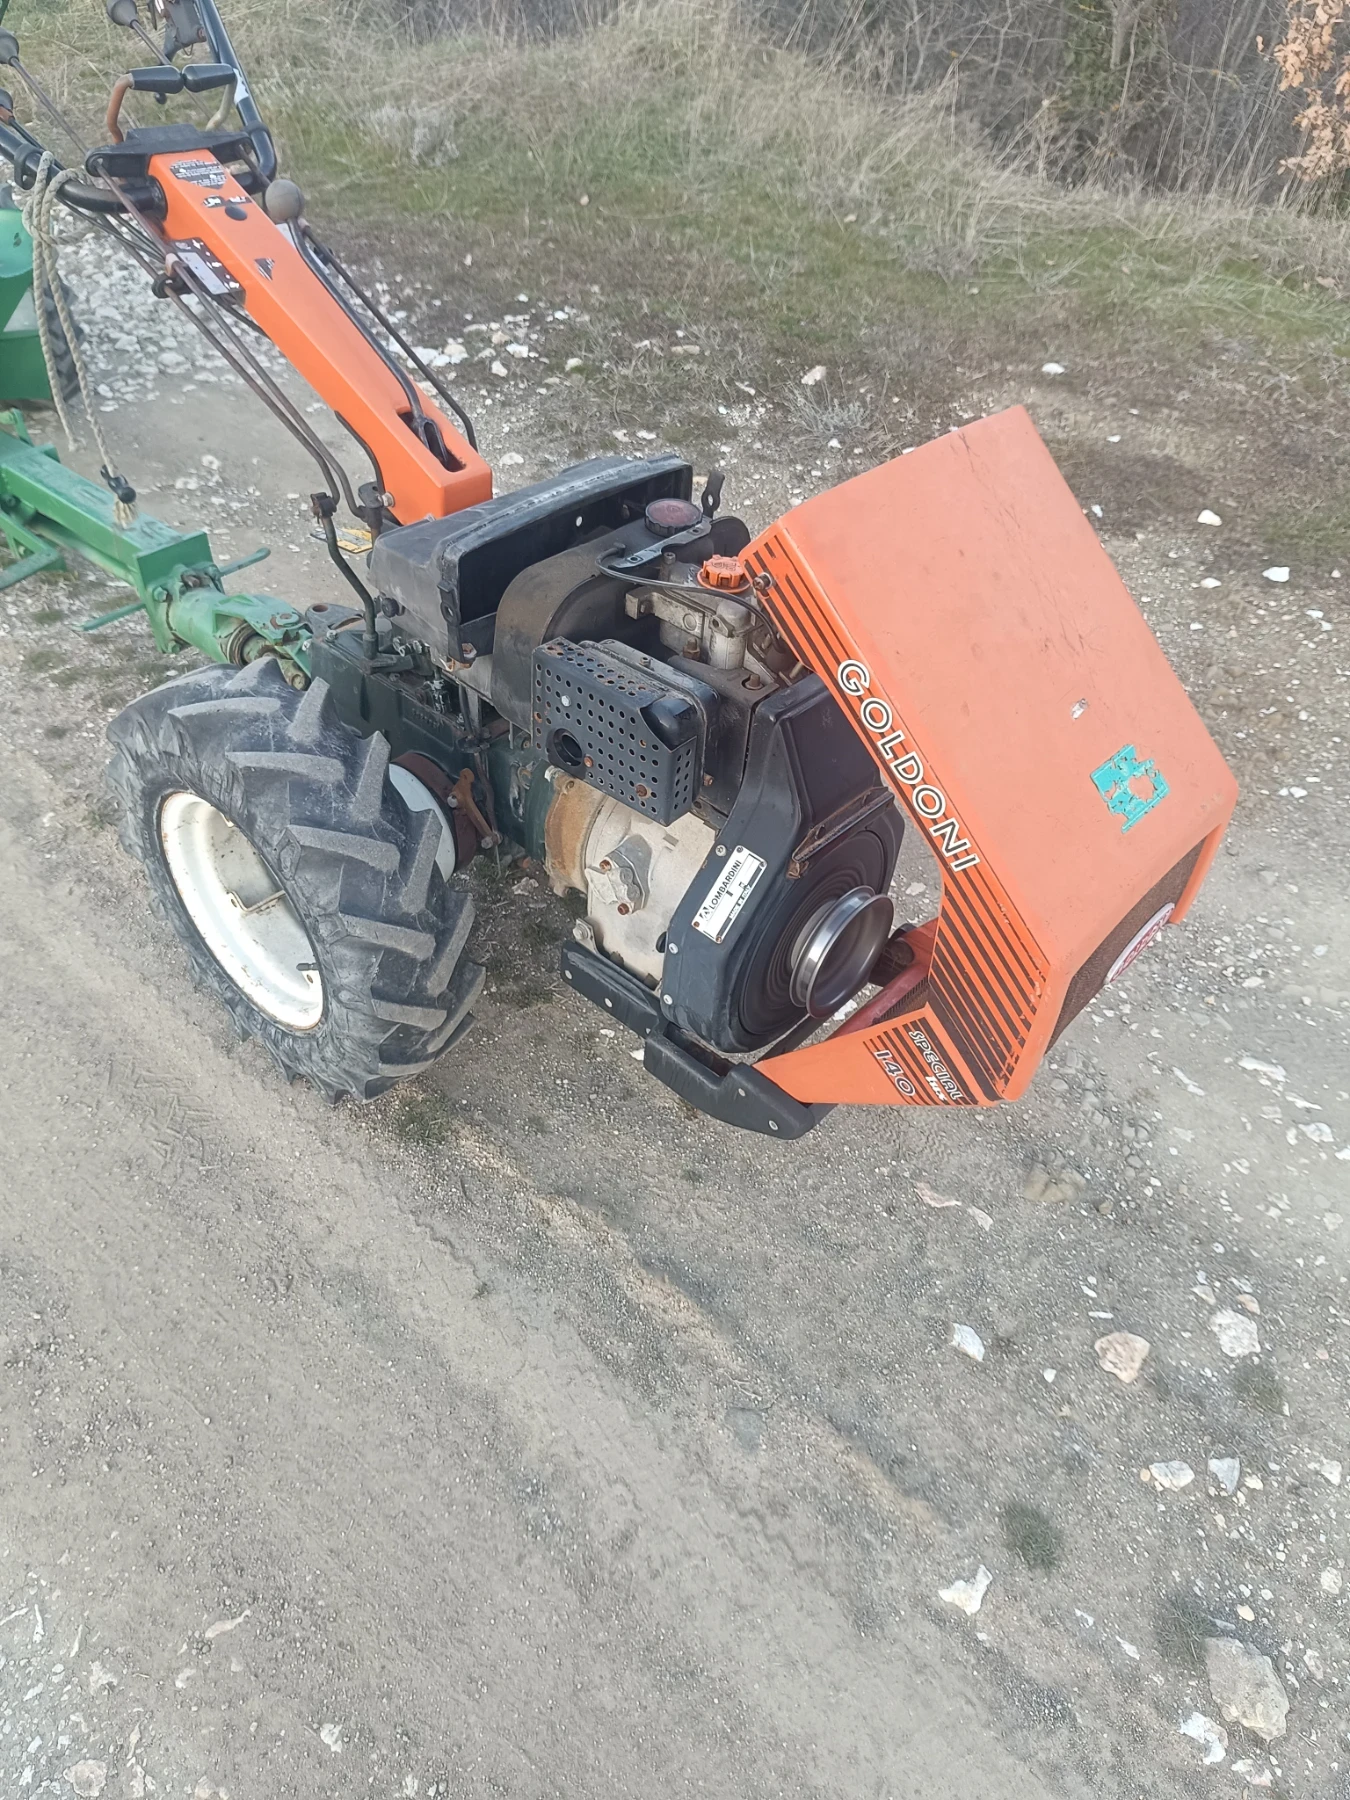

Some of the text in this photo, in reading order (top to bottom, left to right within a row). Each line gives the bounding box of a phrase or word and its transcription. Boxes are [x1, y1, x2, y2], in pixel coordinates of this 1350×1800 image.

[836, 659, 981, 873] GOLDONI
[709, 859, 742, 910] LOMBARDINI
[873, 1049, 916, 1097] 140
[908, 1030, 965, 1101] SPECIAL
